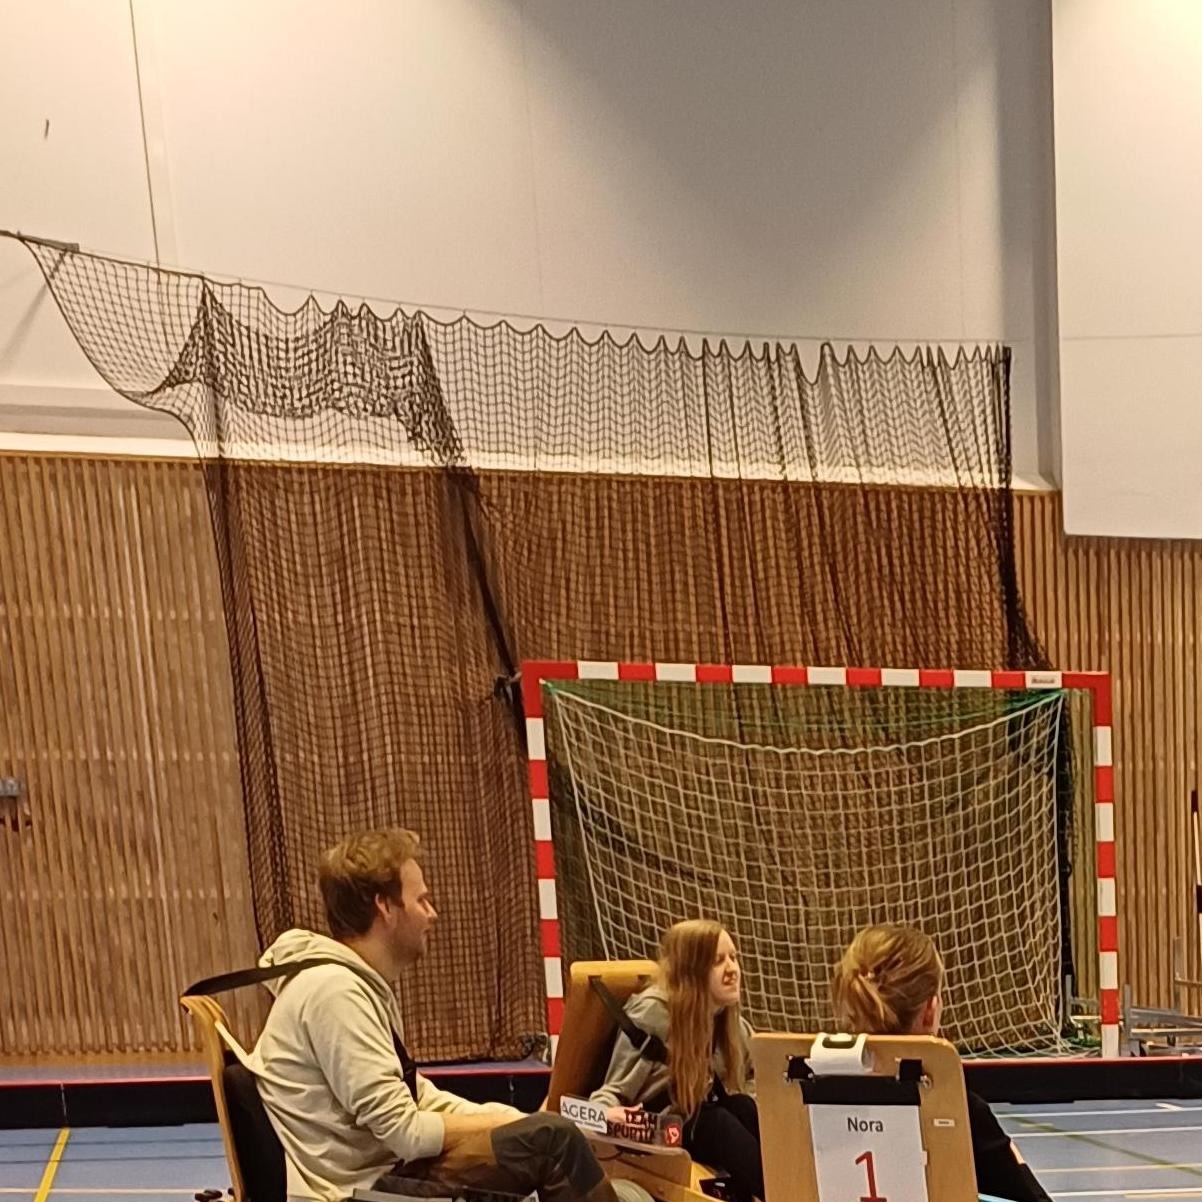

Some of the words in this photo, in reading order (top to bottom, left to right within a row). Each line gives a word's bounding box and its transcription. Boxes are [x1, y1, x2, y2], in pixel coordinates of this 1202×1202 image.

[561, 1101, 608, 1123] AGERA
[846, 1117, 884, 1132] Nora
[855, 1151, 887, 1202] 1
